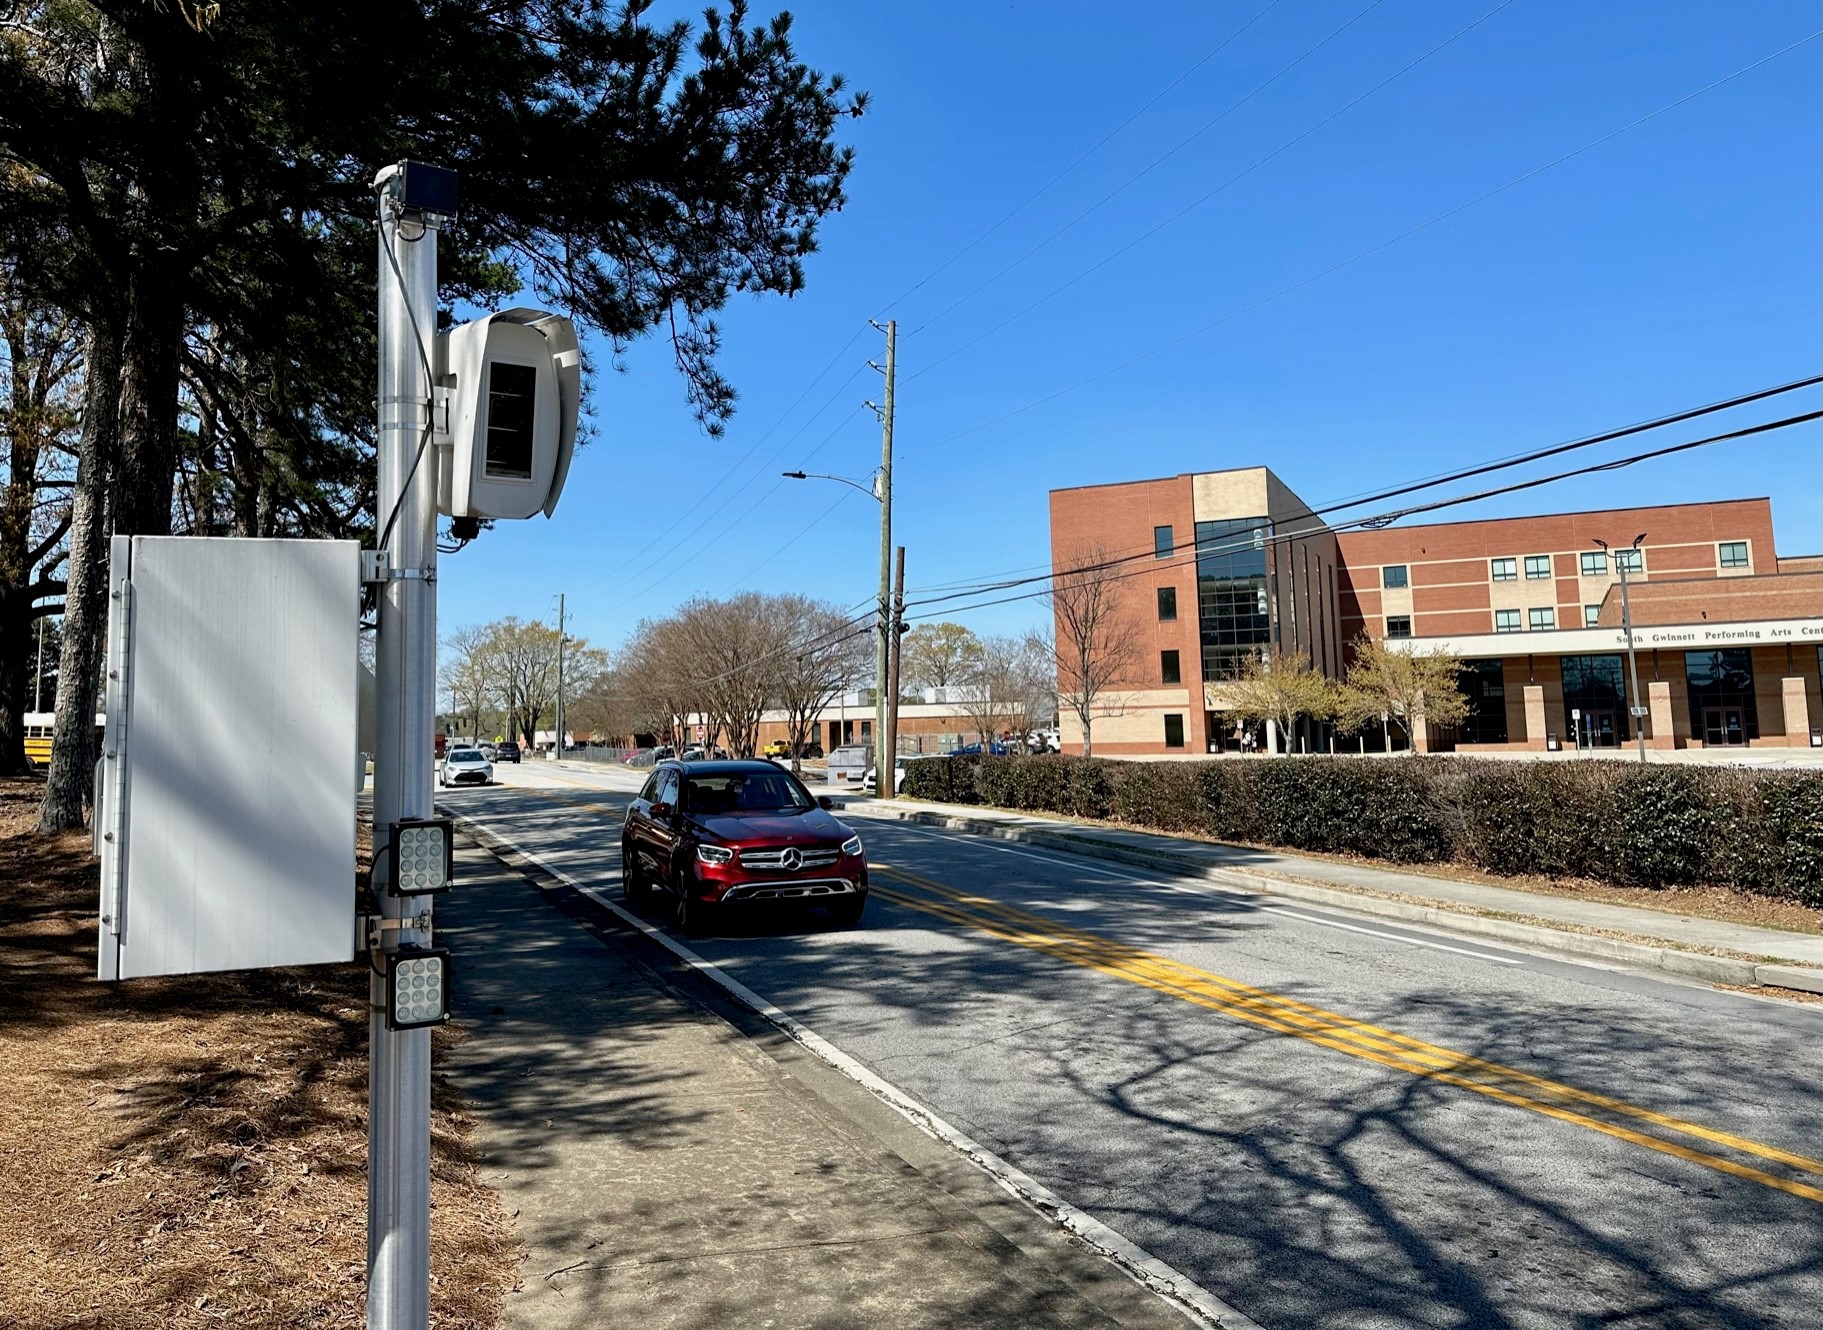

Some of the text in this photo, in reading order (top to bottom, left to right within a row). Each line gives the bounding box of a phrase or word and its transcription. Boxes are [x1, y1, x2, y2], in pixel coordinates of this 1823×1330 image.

[1617, 635, 1643, 643] Soth
[1652, 633, 1695, 642] Gwinnett
[1705, 630, 1760, 639] Performing
[1770, 628, 1792, 636] Arts
